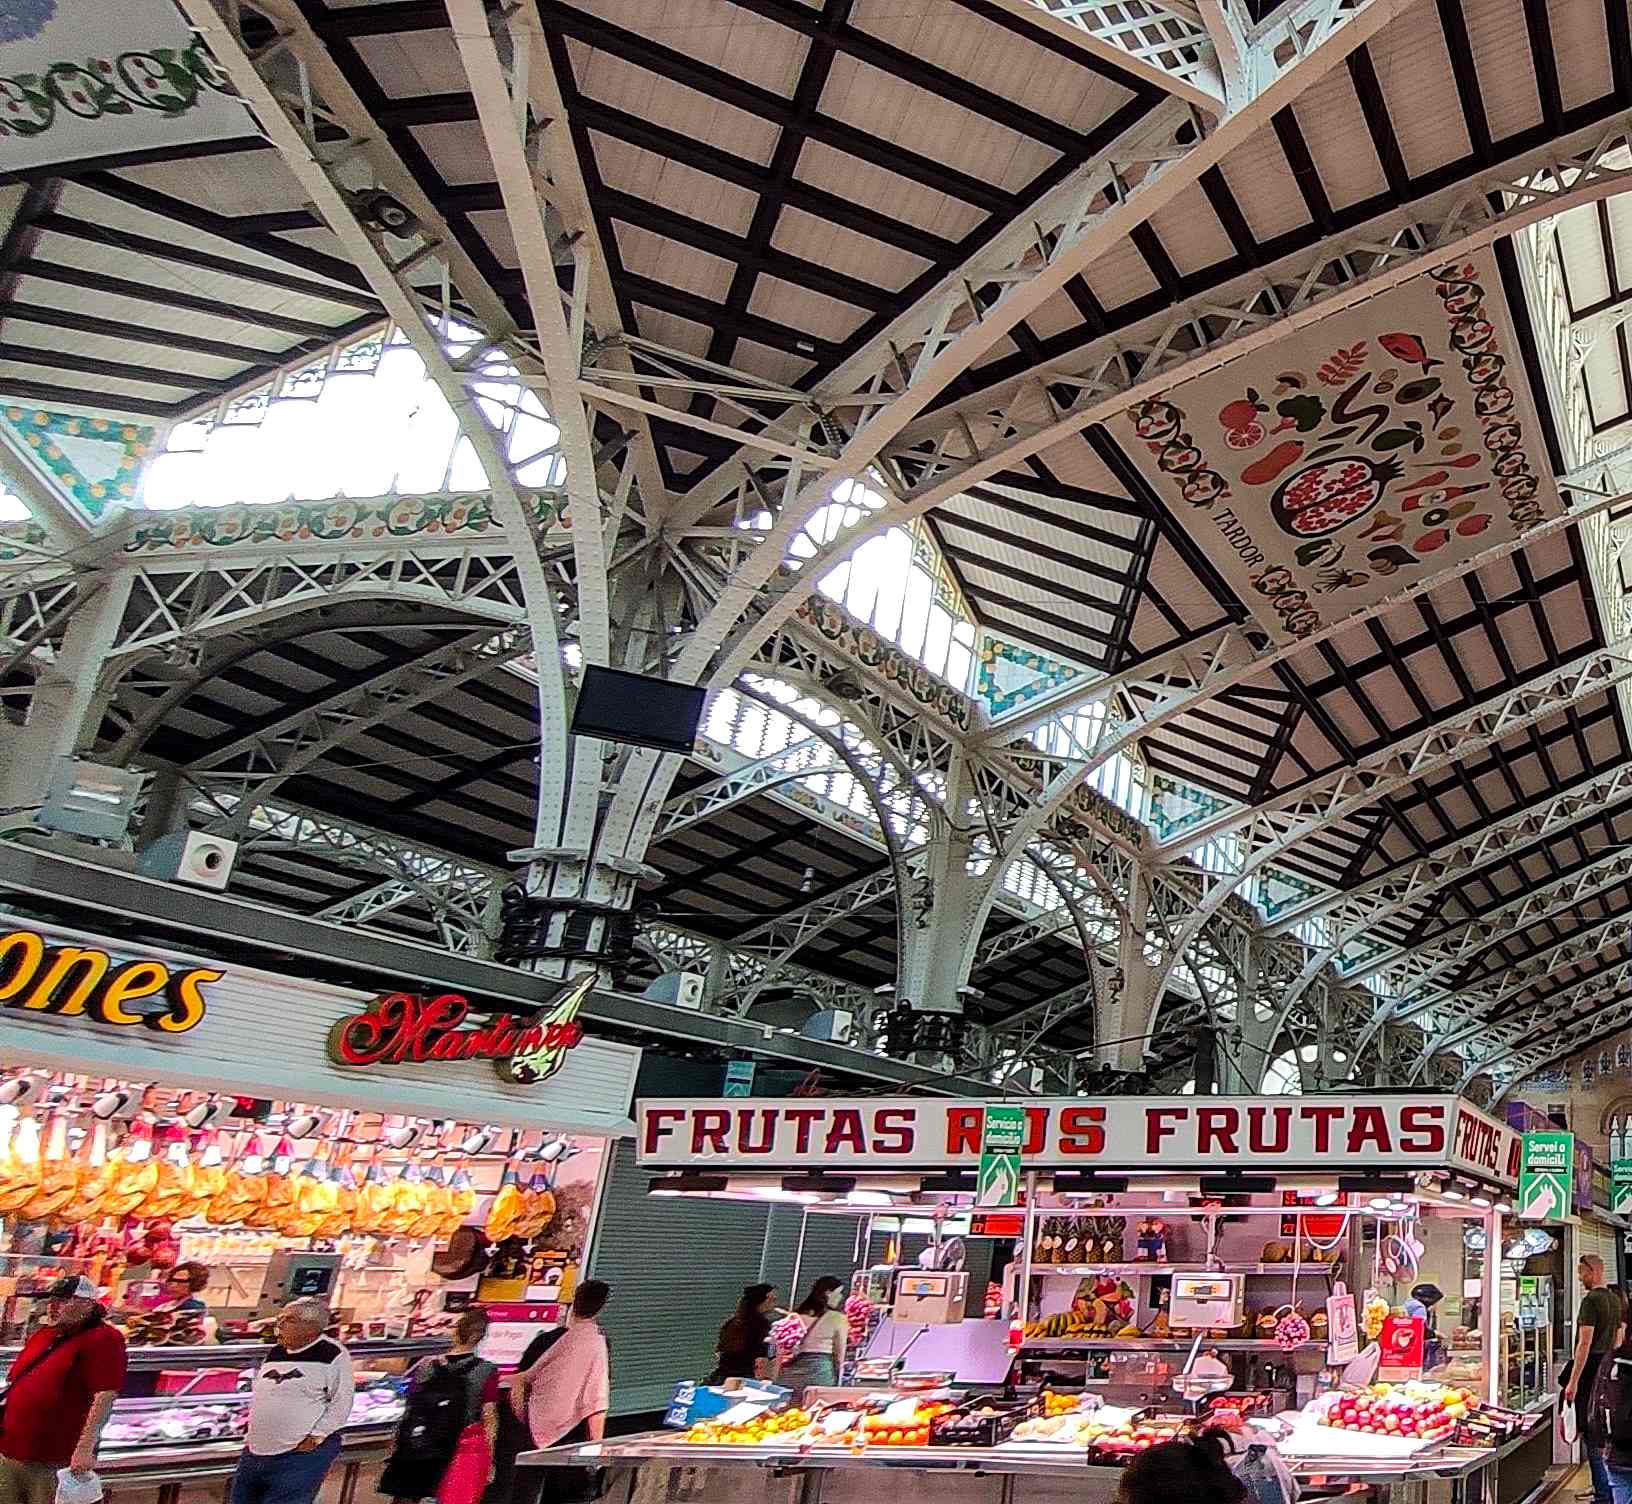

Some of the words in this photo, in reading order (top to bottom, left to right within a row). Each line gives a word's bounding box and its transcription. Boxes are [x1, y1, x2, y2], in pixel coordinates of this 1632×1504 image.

[1213, 507, 1265, 568] TARDOR
[644, 1107, 917, 1155] FRUTAS
[1144, 1106, 1446, 1155] FRUTAS
